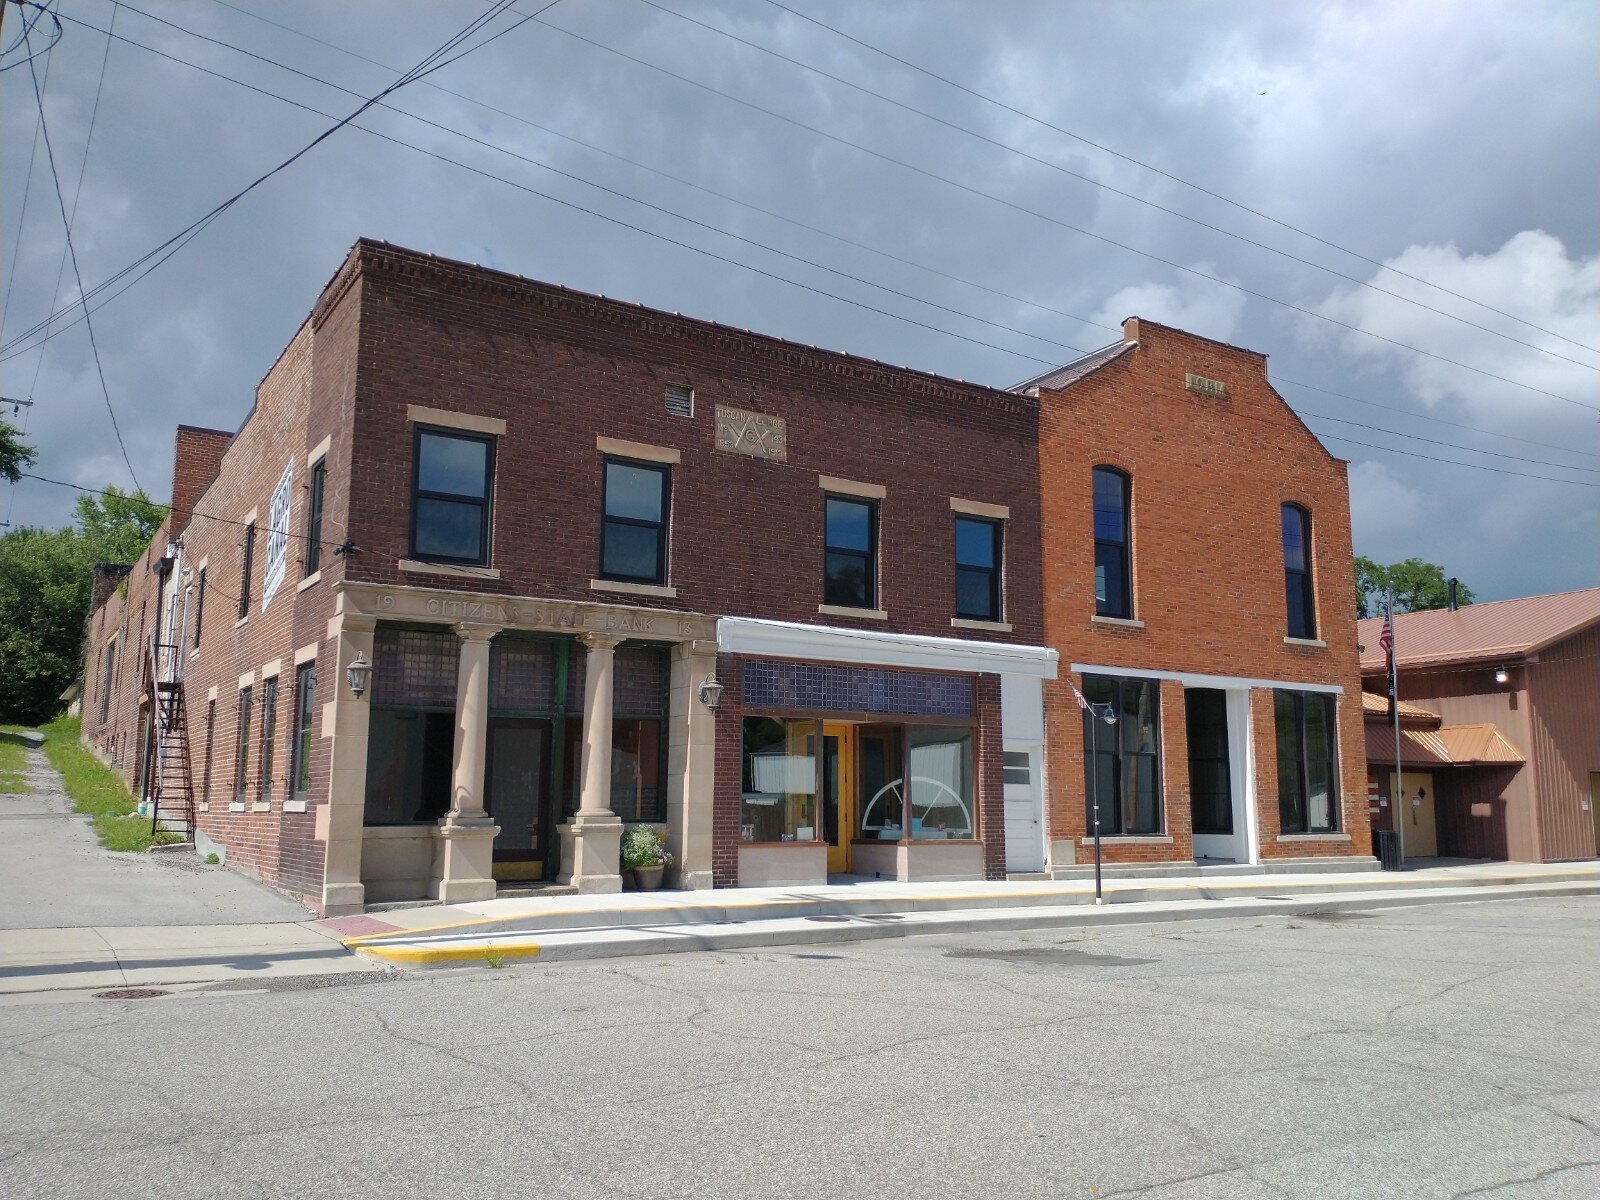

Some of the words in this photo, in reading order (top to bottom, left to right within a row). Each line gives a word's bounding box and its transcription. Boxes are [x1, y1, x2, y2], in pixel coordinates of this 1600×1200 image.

[716, 407, 746, 422] TUSCAN
[745, 429, 755, 441] G
[376, 594, 395, 611] 19
[605, 614, 656, 632] BANK
[677, 620, 693, 636] 13
